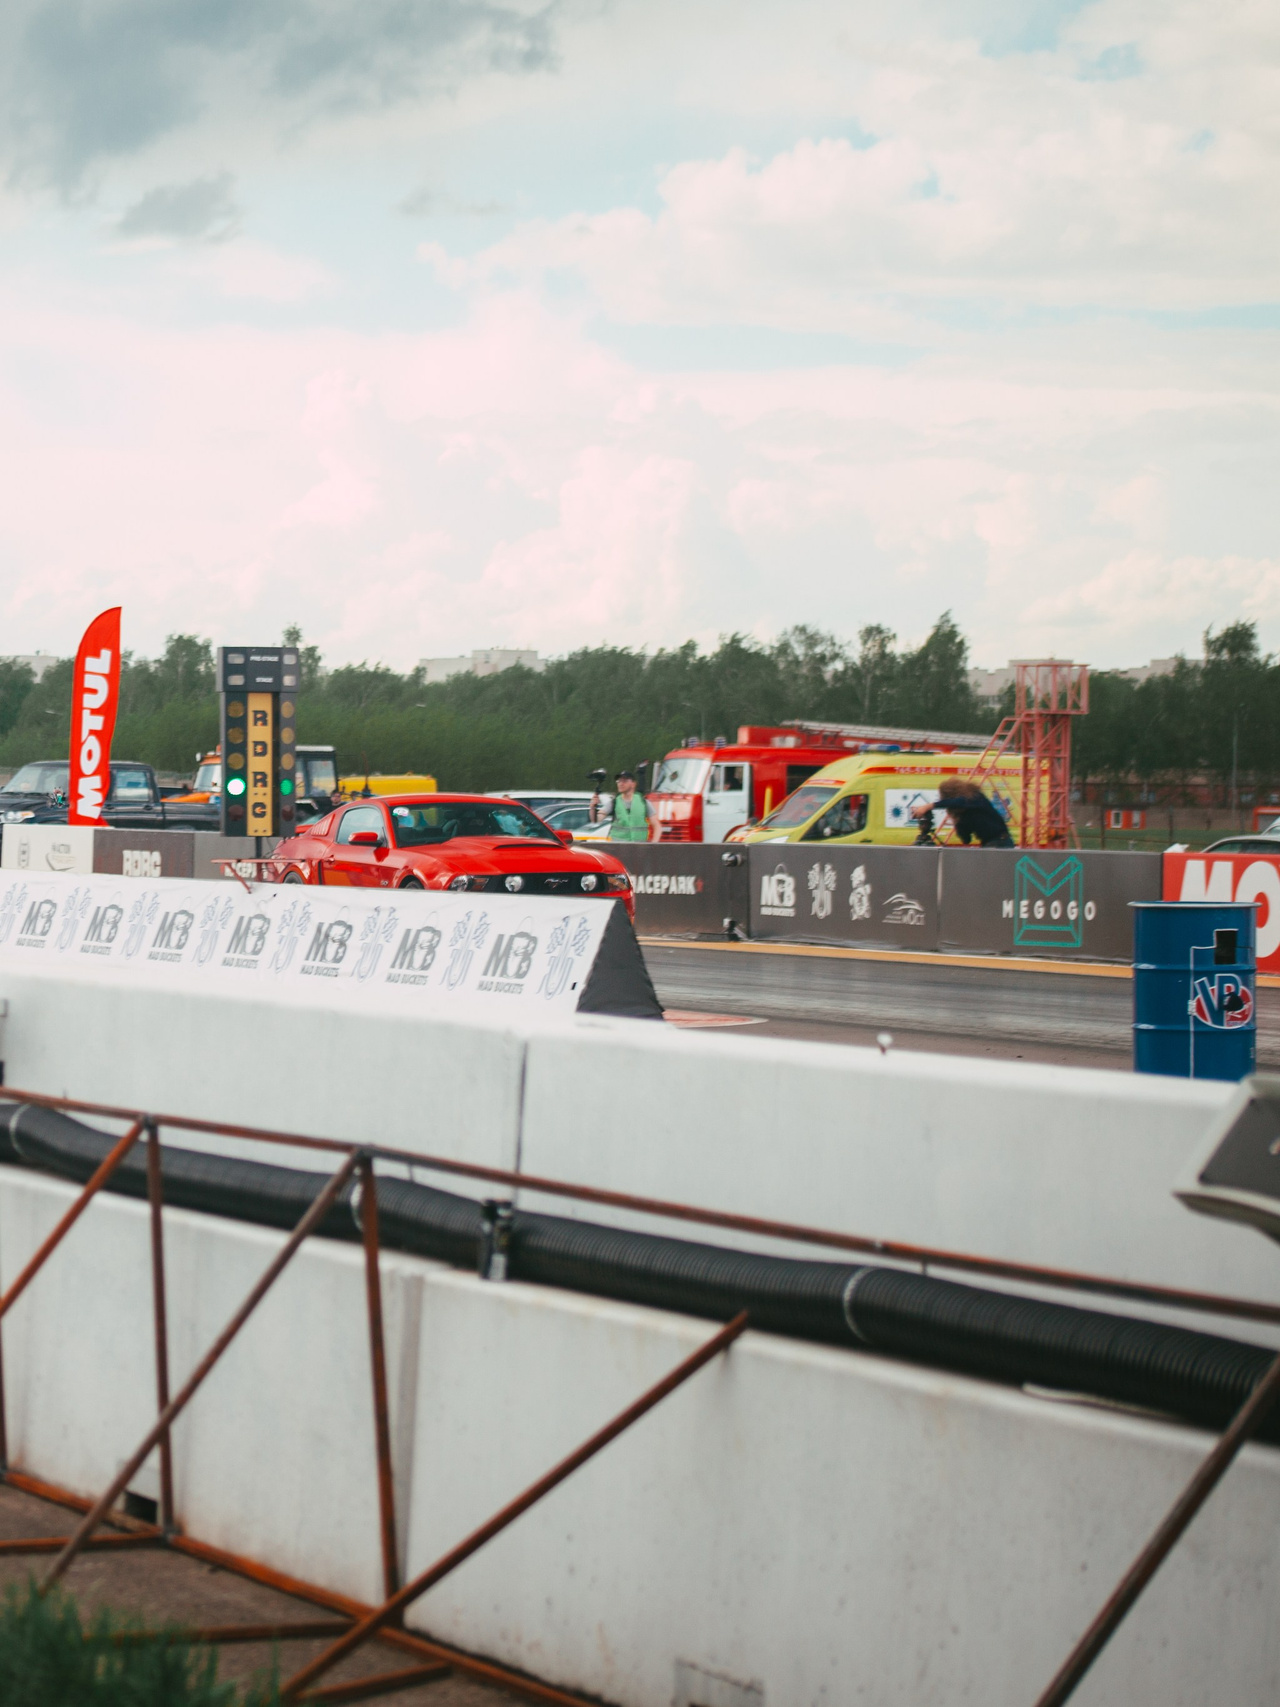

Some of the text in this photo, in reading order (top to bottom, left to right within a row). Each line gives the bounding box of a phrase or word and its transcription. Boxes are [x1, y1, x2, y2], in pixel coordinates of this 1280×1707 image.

[77, 648, 112, 820] MOTUL
[1002, 899, 1097, 921] MEGOGO
[1193, 973, 1243, 1029] VP
